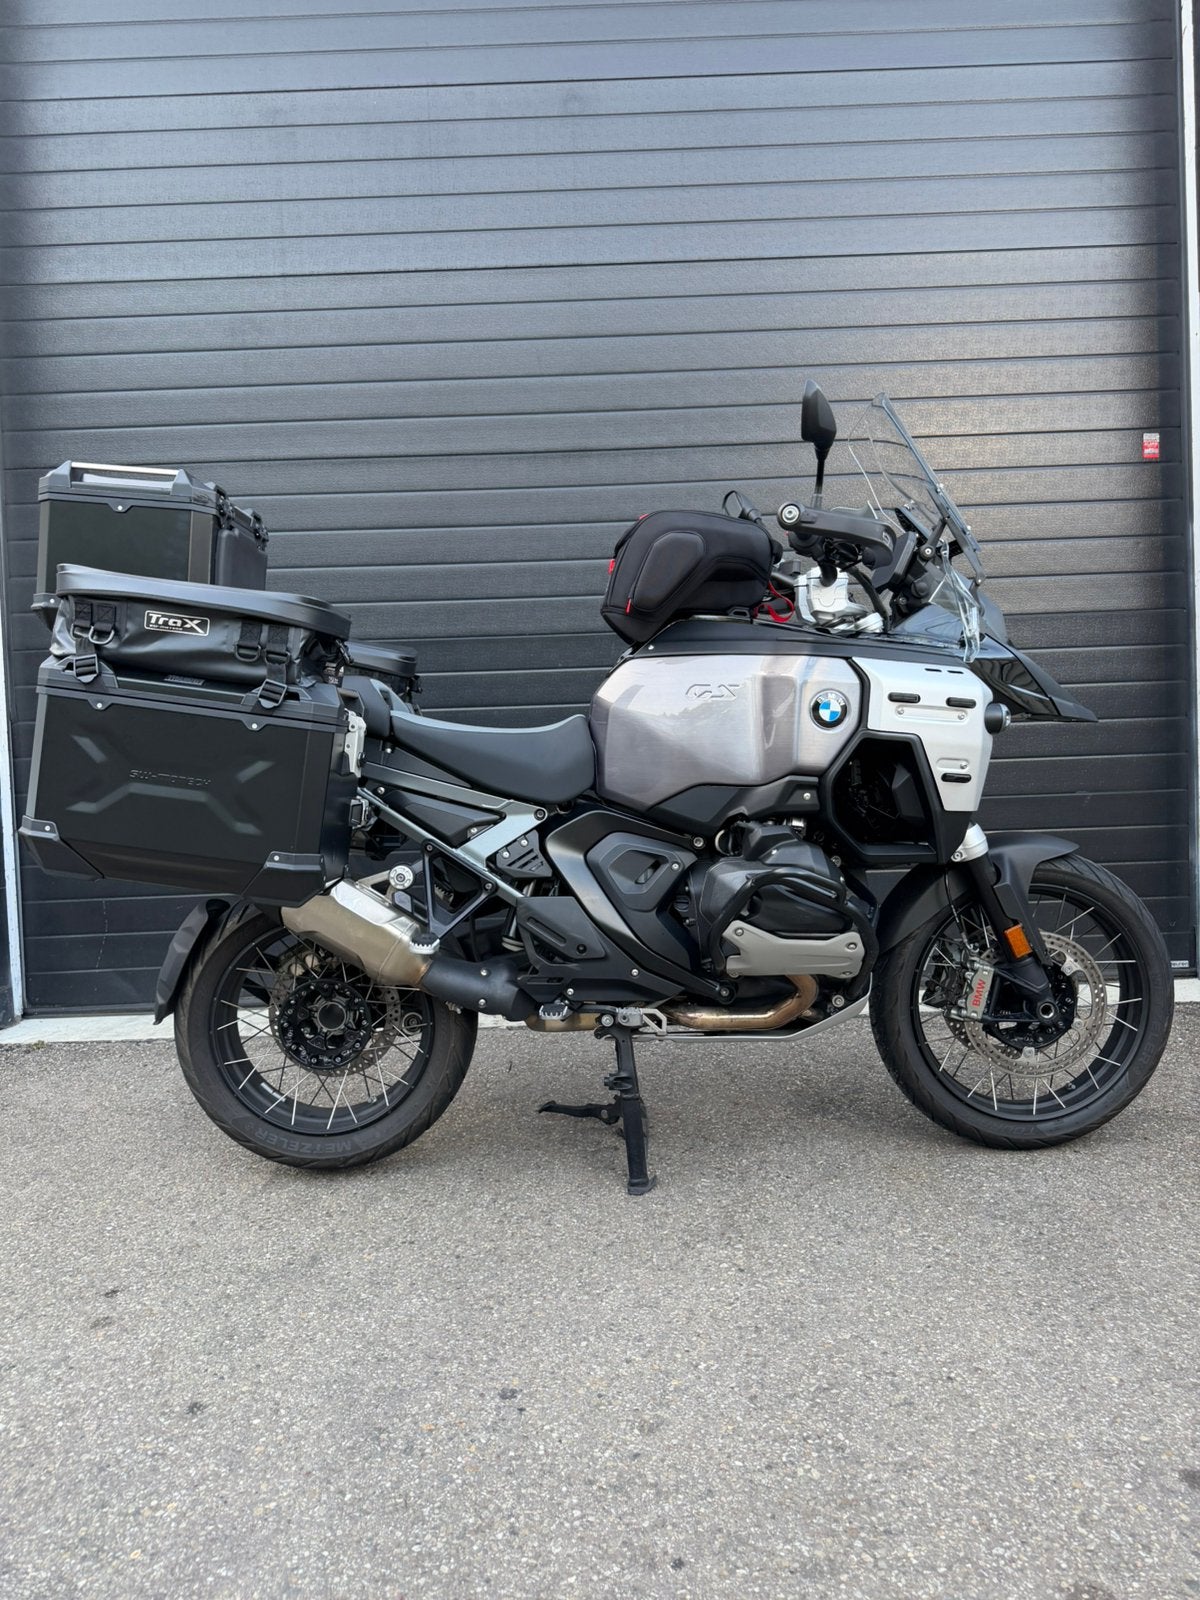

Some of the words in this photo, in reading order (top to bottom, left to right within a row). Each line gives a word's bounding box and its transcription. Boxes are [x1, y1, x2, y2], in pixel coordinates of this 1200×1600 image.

[685, 683, 740, 700] GS
[816, 692, 846, 706] BMW
[971, 978, 986, 1008] BMW
[254, 1127, 352, 1153] METZELER
